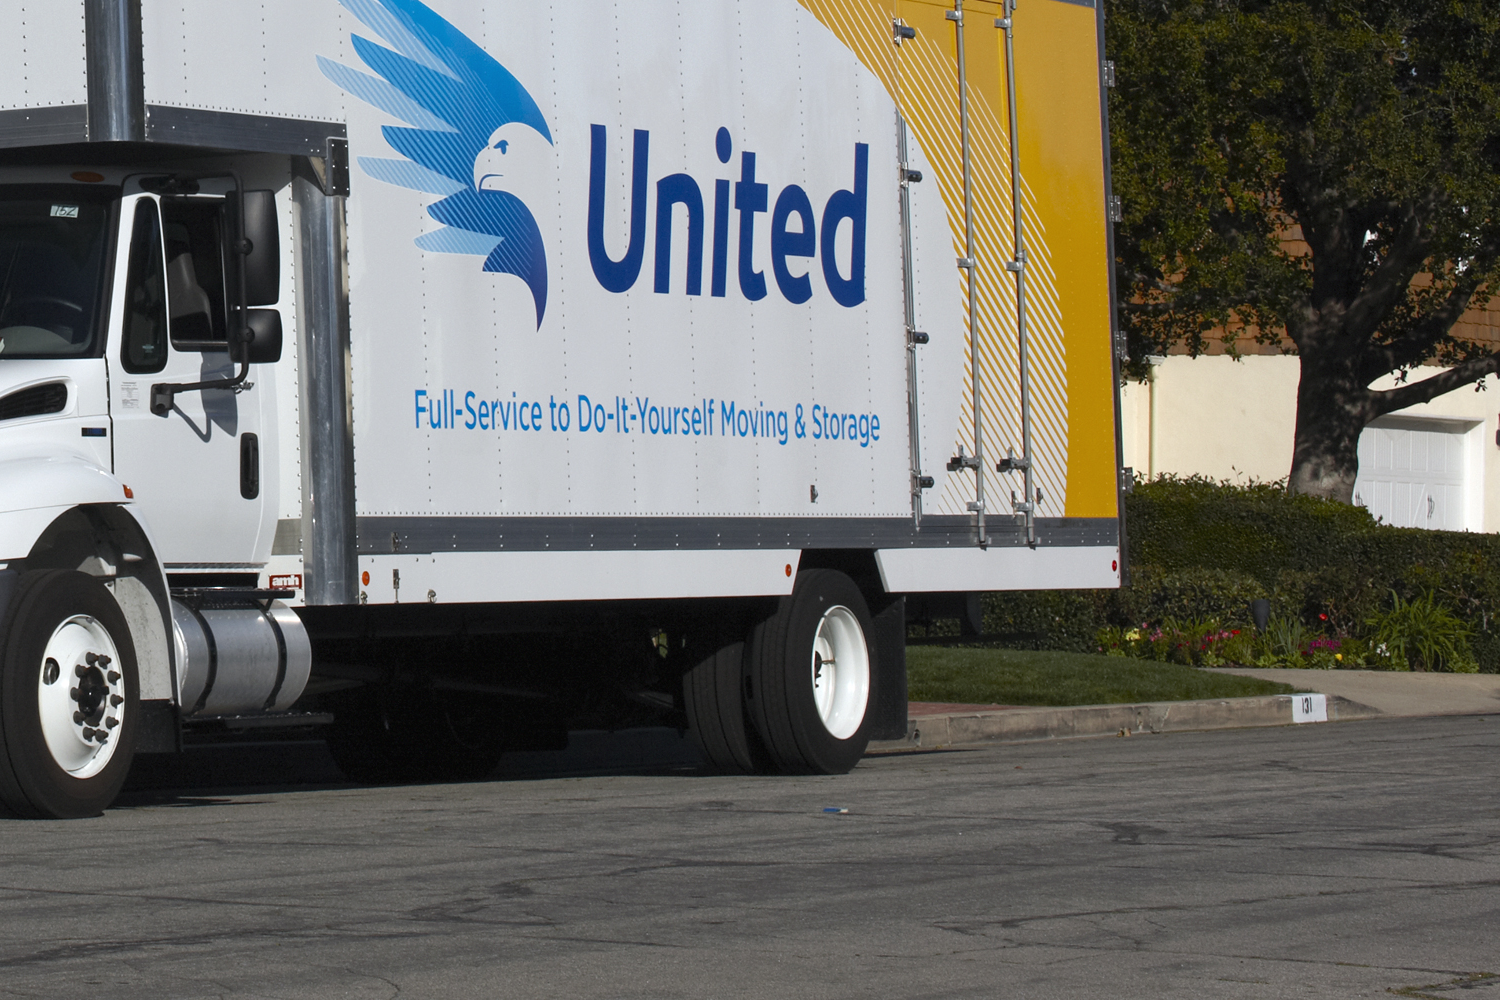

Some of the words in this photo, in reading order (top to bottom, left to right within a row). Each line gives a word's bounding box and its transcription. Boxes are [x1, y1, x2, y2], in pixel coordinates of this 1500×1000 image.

[588, 124, 869, 307] United
[415, 389, 542, 431] Full-Service
[550, 396, 570, 432] to
[578, 395, 714, 435] Do-It-Yourself
[722, 401, 788, 445] Moving
[795, 404, 806, 439] &
[813, 404, 880, 448] Storage
[272, 574, 300, 586] amh
[1301, 697, 1313, 714] 131
